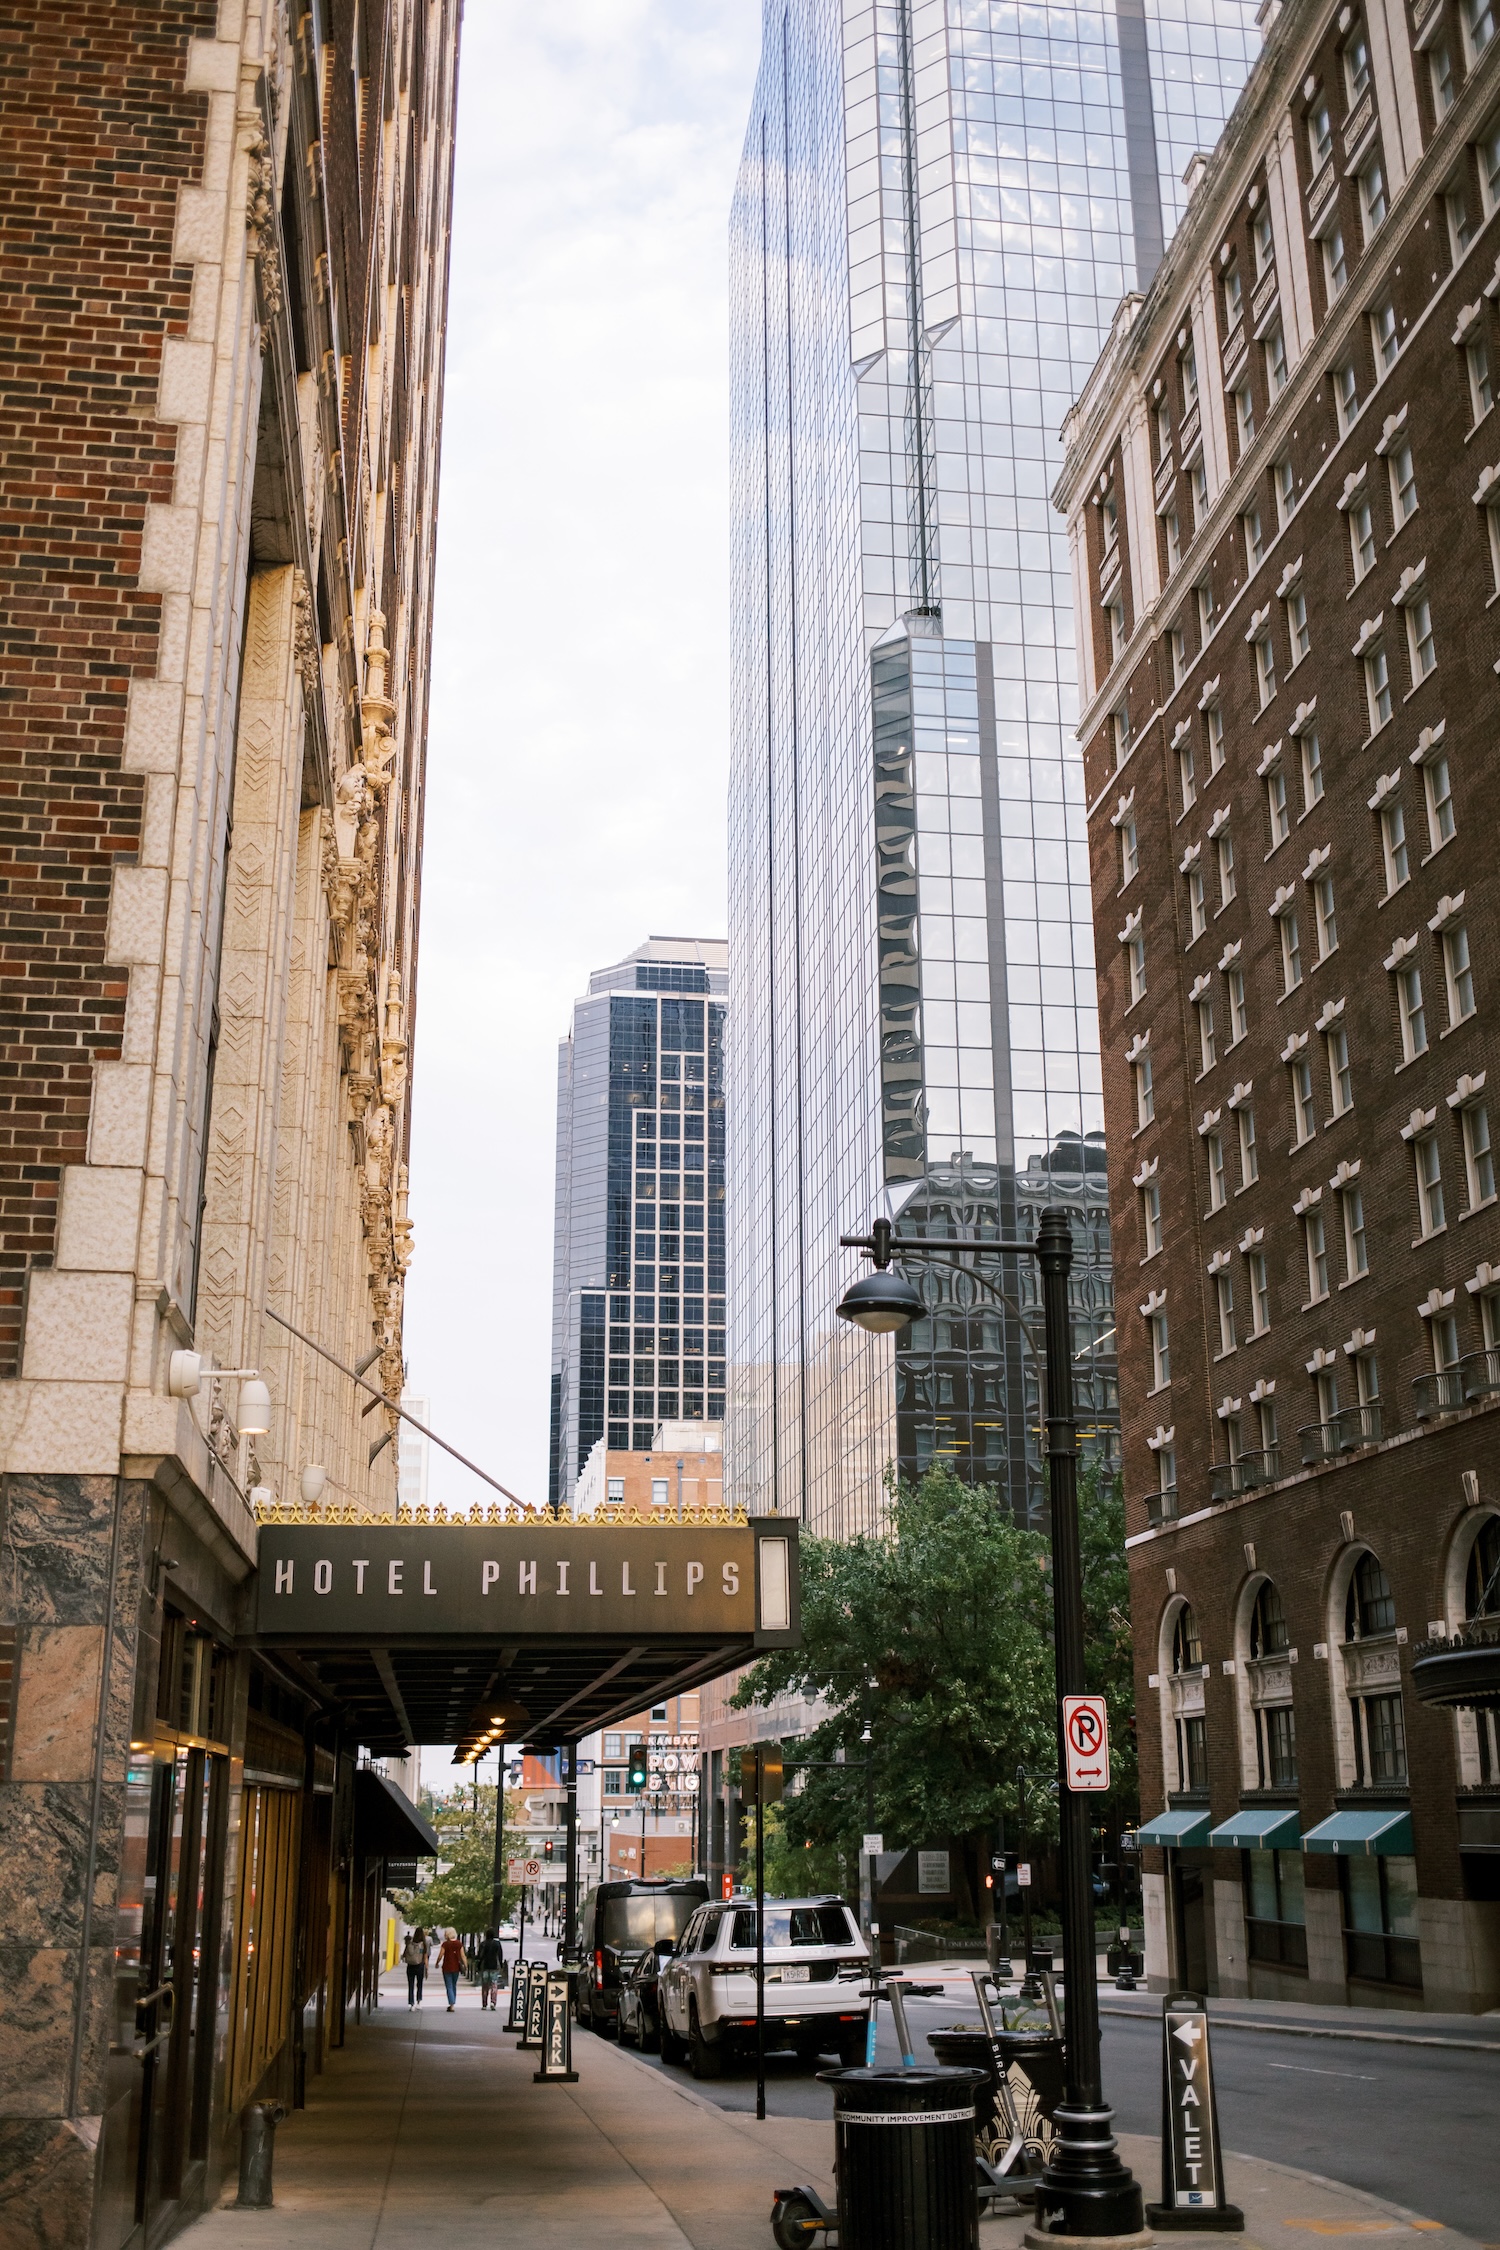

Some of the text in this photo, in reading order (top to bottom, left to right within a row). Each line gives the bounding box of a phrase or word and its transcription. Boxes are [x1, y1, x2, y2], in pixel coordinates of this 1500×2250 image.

[274, 1559, 740, 1597] HOTEL PHILLIPS
[647, 1734, 698, 1746] KANSAS
[648, 1753, 699, 1772] POW
[665, 1773, 700, 1791] LIG
[516, 1980, 525, 2020] PARK
[531, 1987, 542, 2036] PARK
[551, 2003, 563, 2064] PARK
[991, 2043, 1006, 2079] BIRD
[843, 2114, 885, 2123] COMMUNITY
[887, 2112, 946, 2123] IMPROVEMENT
[947, 2110, 971, 2120] DISTRICT
[1179, 2058, 1203, 2185] VALET
